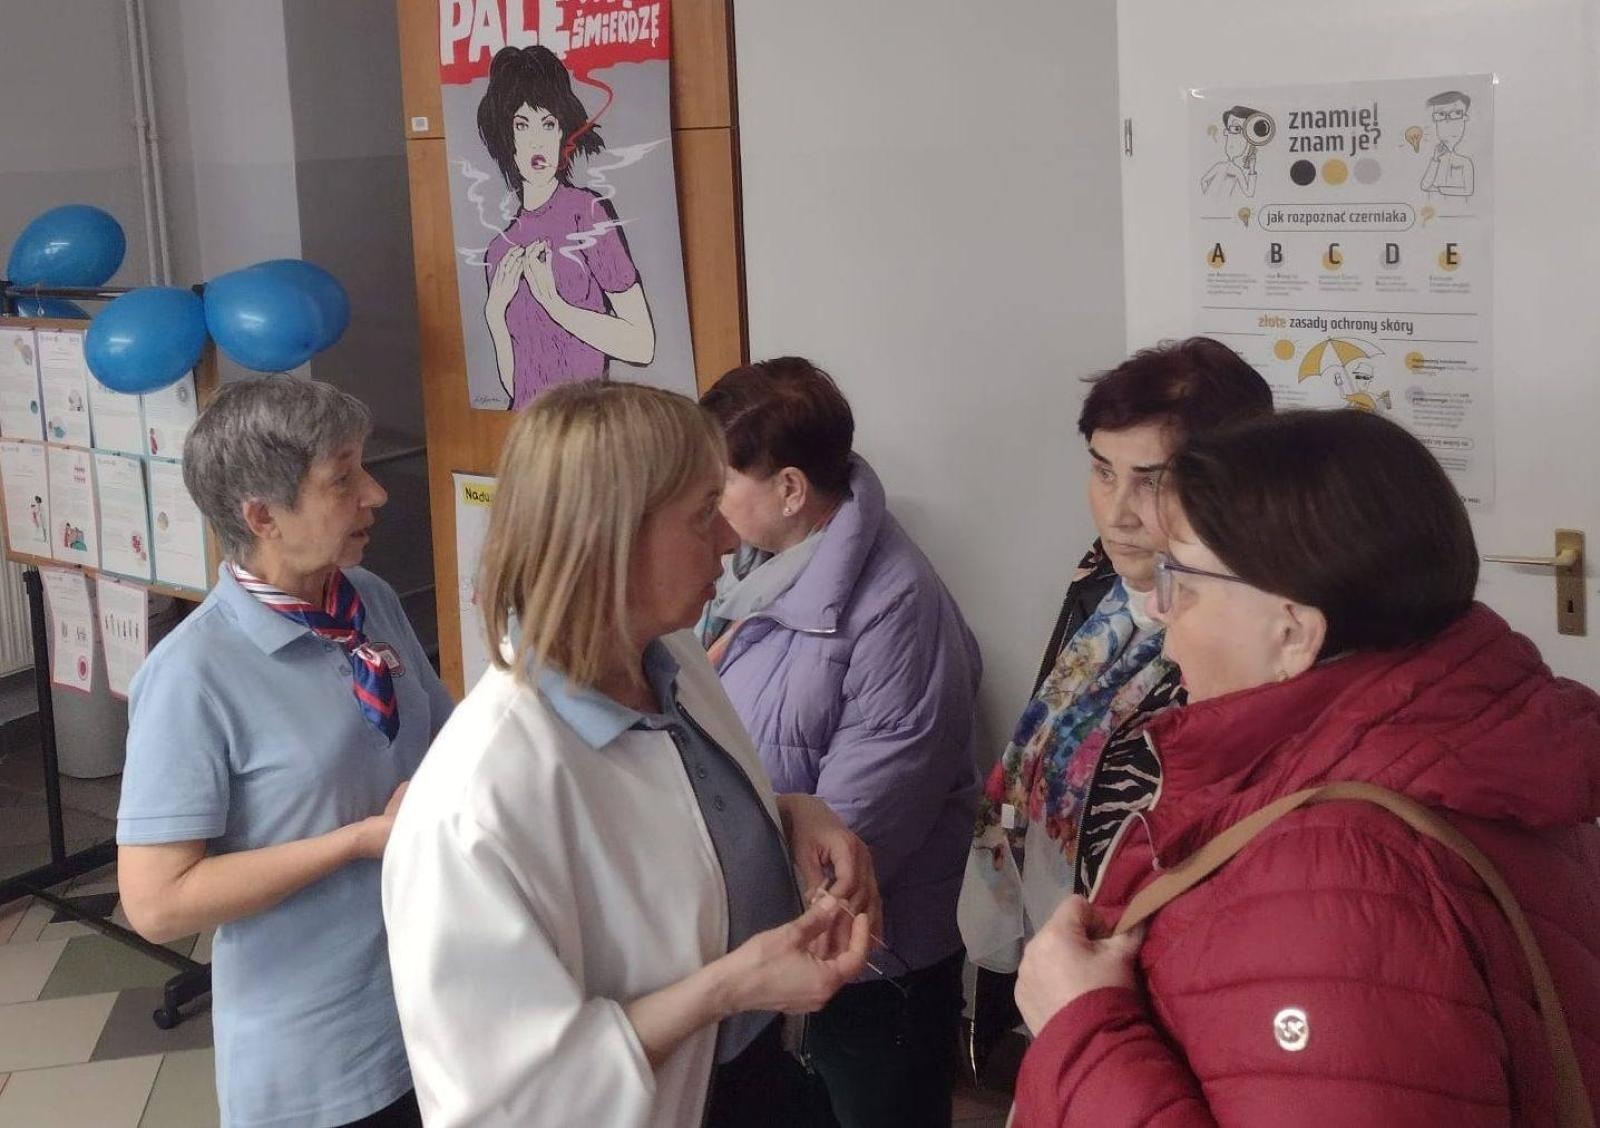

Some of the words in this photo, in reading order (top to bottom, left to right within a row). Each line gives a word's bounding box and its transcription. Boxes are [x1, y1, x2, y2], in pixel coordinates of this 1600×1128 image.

[1288, 102, 1379, 132] znamię!
[1288, 134, 1344, 153] znam
[1349, 128, 1382, 157] je?
[1266, 210, 1284, 226] jak
[1287, 210, 1346, 226] rozpoznać
[1349, 210, 1407, 224] czerniaka
[1211, 243, 1226, 264] A
[1270, 243, 1283, 264] B
[1328, 243, 1341, 265] C
[1385, 243, 1400, 265] D
[1446, 243, 1458, 265] E
[1258, 314, 1287, 328] złote
[1289, 316, 1328, 332] zasady
[1330, 316, 1377, 334] ochrony
[1380, 318, 1413, 335] skóry
[465, 486, 493, 503] Nadu
